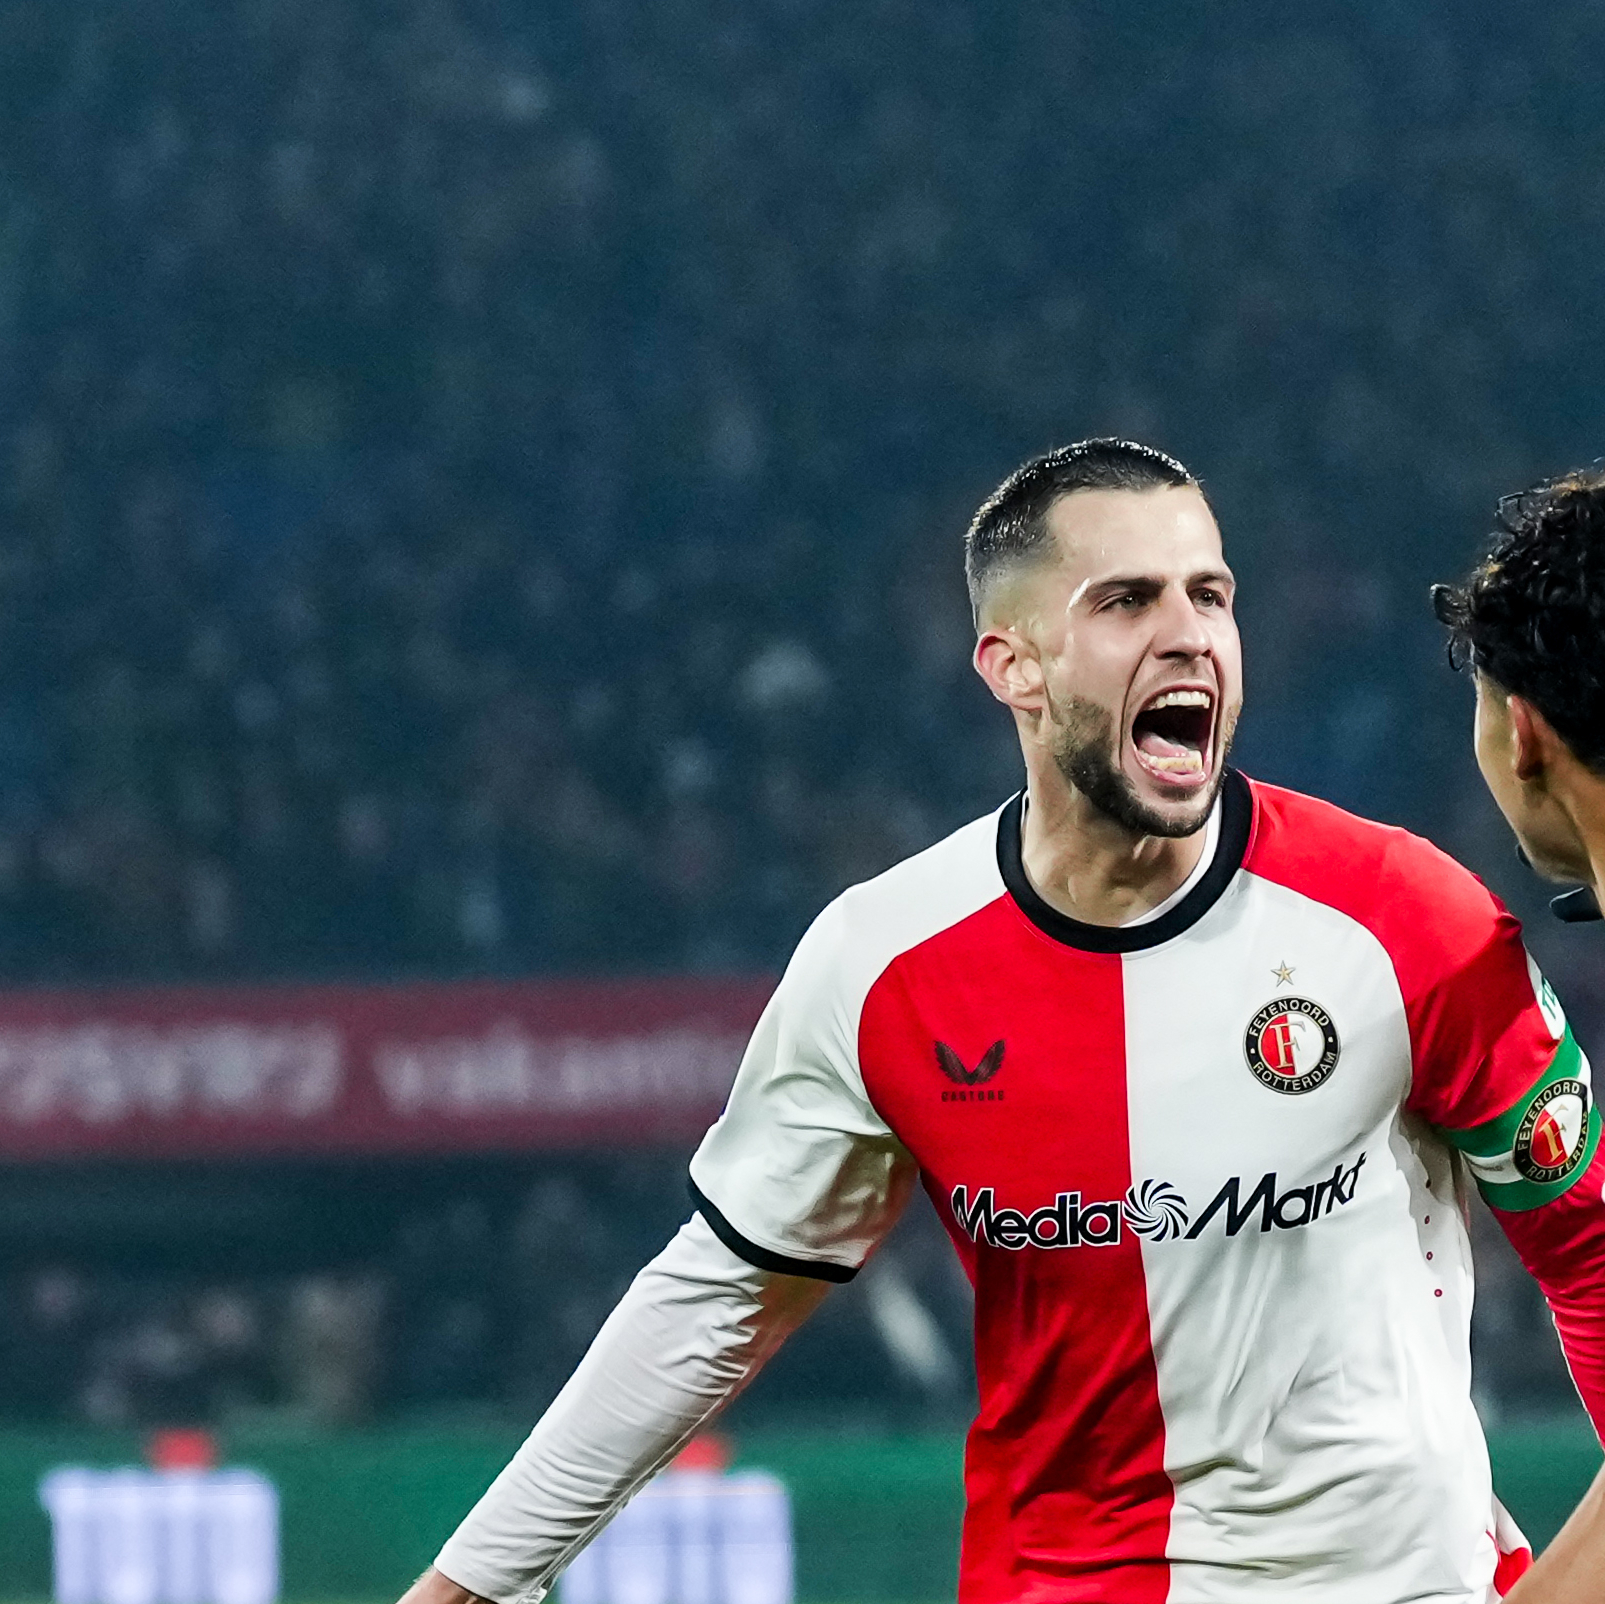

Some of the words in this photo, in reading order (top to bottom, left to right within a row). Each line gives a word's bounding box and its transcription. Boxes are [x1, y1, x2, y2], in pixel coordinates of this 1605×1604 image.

[1249, 999, 1330, 1037] FEYENOORD
[1252, 1051, 1337, 1091] ROTTERDAM
[1517, 1081, 1580, 1151] FEYENOORD
[950, 1184, 1122, 1251] Media
[1183, 1150, 1367, 1239] Markt
